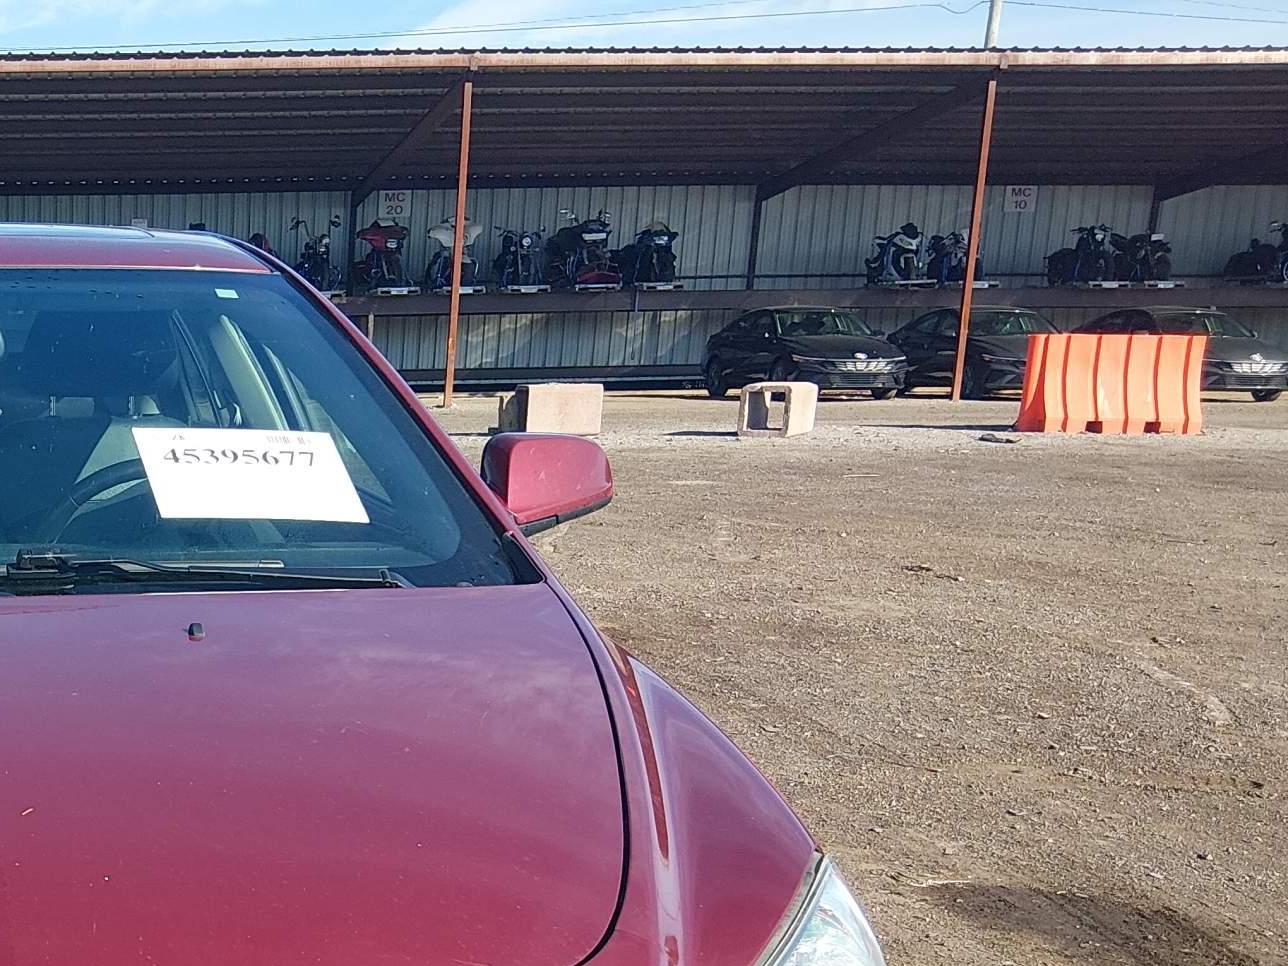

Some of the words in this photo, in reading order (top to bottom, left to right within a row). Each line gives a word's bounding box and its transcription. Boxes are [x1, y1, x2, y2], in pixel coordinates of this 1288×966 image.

[384, 192, 406, 203] MC
[1011, 187, 1032, 198] MC
[1014, 199, 1027, 210] 10
[386, 205, 403, 216] 20
[162, 448, 314, 467] 45395677
